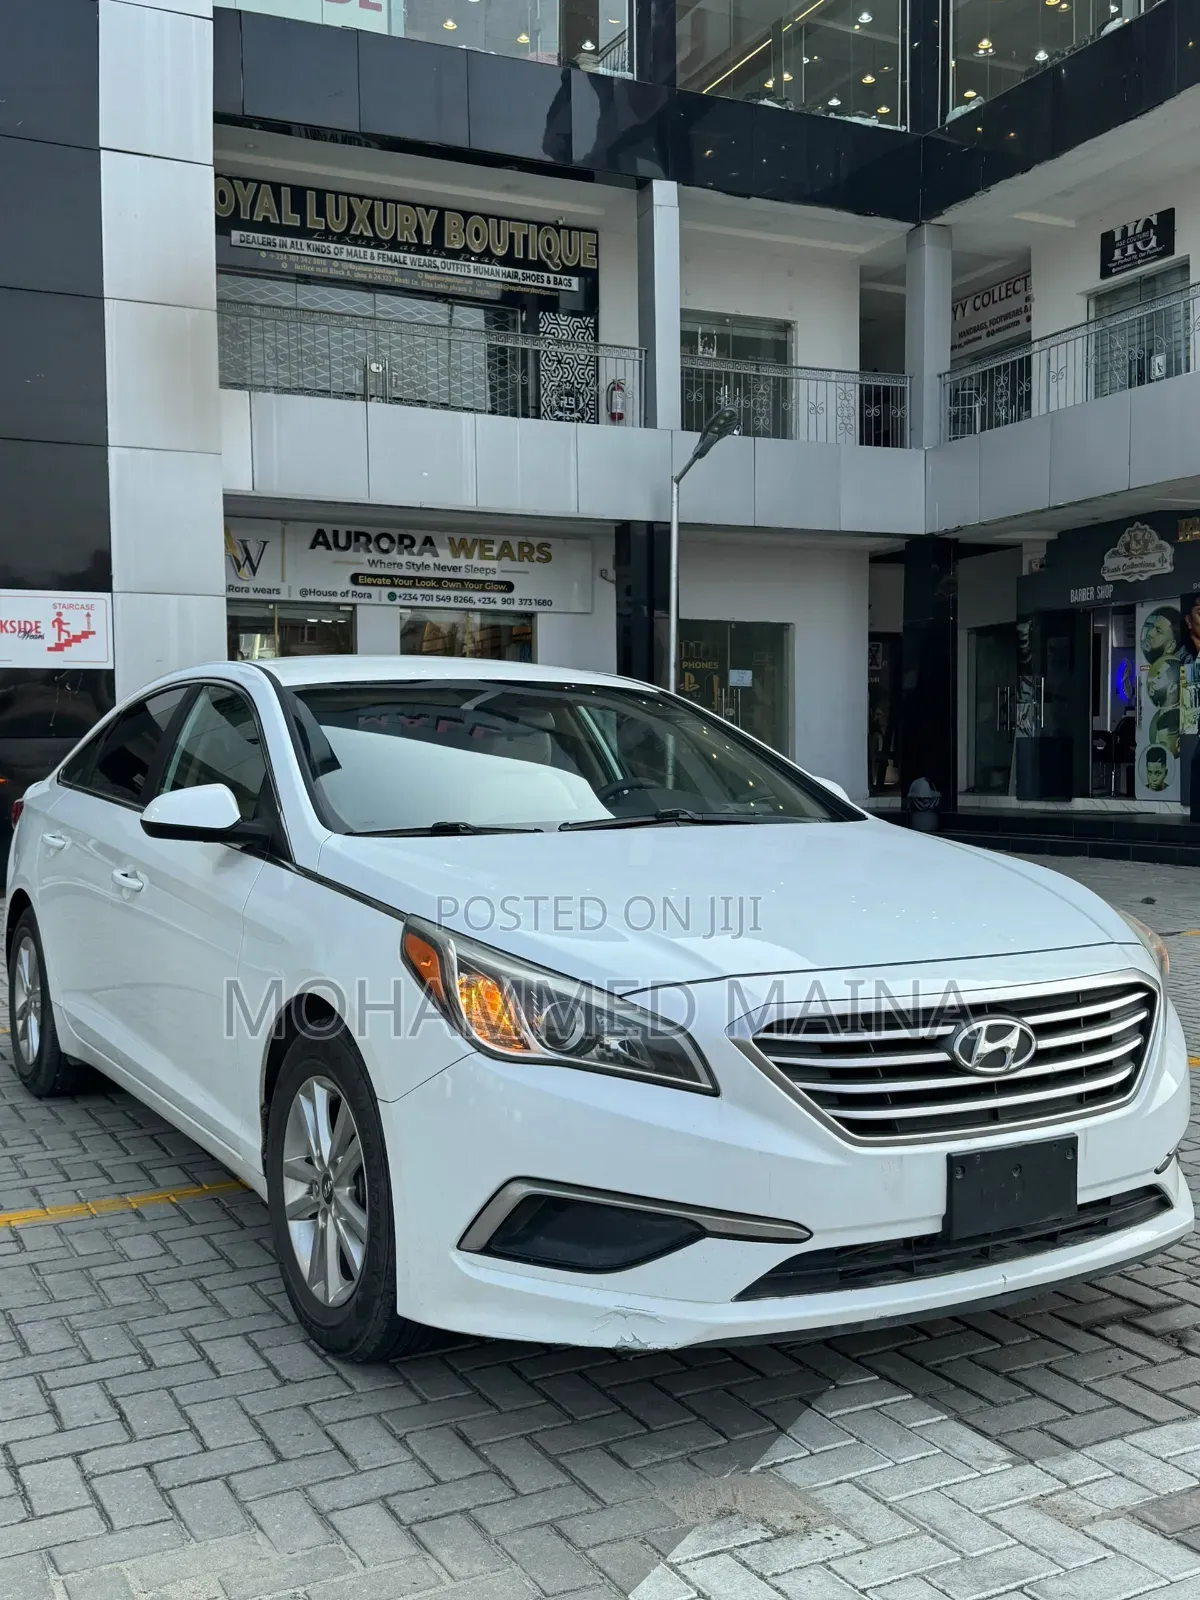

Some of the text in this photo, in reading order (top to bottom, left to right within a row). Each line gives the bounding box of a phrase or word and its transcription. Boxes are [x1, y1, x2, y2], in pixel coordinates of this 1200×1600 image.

[215, 177, 597, 271] OYAL LUXURY BOUTIQUE
[239, 233, 277, 248] DEALERS
[278, 239, 288, 249] IN
[290, 240, 304, 251] ALL
[307, 243, 332, 255] KINDS
[333, 246, 344, 257] OF
[346, 248, 367, 260] MALE
[369, 251, 375, 261] &
[377, 252, 407, 265] FEMALE
[409, 256, 440, 271] WEARS,
[441, 259, 471, 273] OUTFITS
[473, 264, 500, 278] HUMAN
[521, 271, 544, 285] SHOES
[546, 275, 551, 285] &
[553, 275, 572, 287] BAGS
[973, 275, 1031, 311] COLLECT
[988, 307, 1023, 327] FOOTWEARS
[308, 528, 553, 564] AURORA WEARS
[367, 558, 497, 576] Where Style Never Sleeps
[253, 586, 281, 595] wears
[358, 575, 391, 585] Elevate
[393, 577, 413, 586] Your
[441, 580, 461, 589] Own
[464, 581, 483, 590] Your
[300, 588, 372, 599] @House of Rora
[397, 593, 418, 601] +234
[420, 594, 434, 602] 701
[435, 594, 452, 602] 549
[477, 596, 497, 605] +234
[501, 597, 515, 606] 901
[518, 598, 533, 606] 373
[534, 598, 553, 607] 1680
[1070, 584, 1114, 603] BARBER SHOP
[52, 602, 95, 611] STAIRCASE
[682, 661, 719, 669] PHONES
